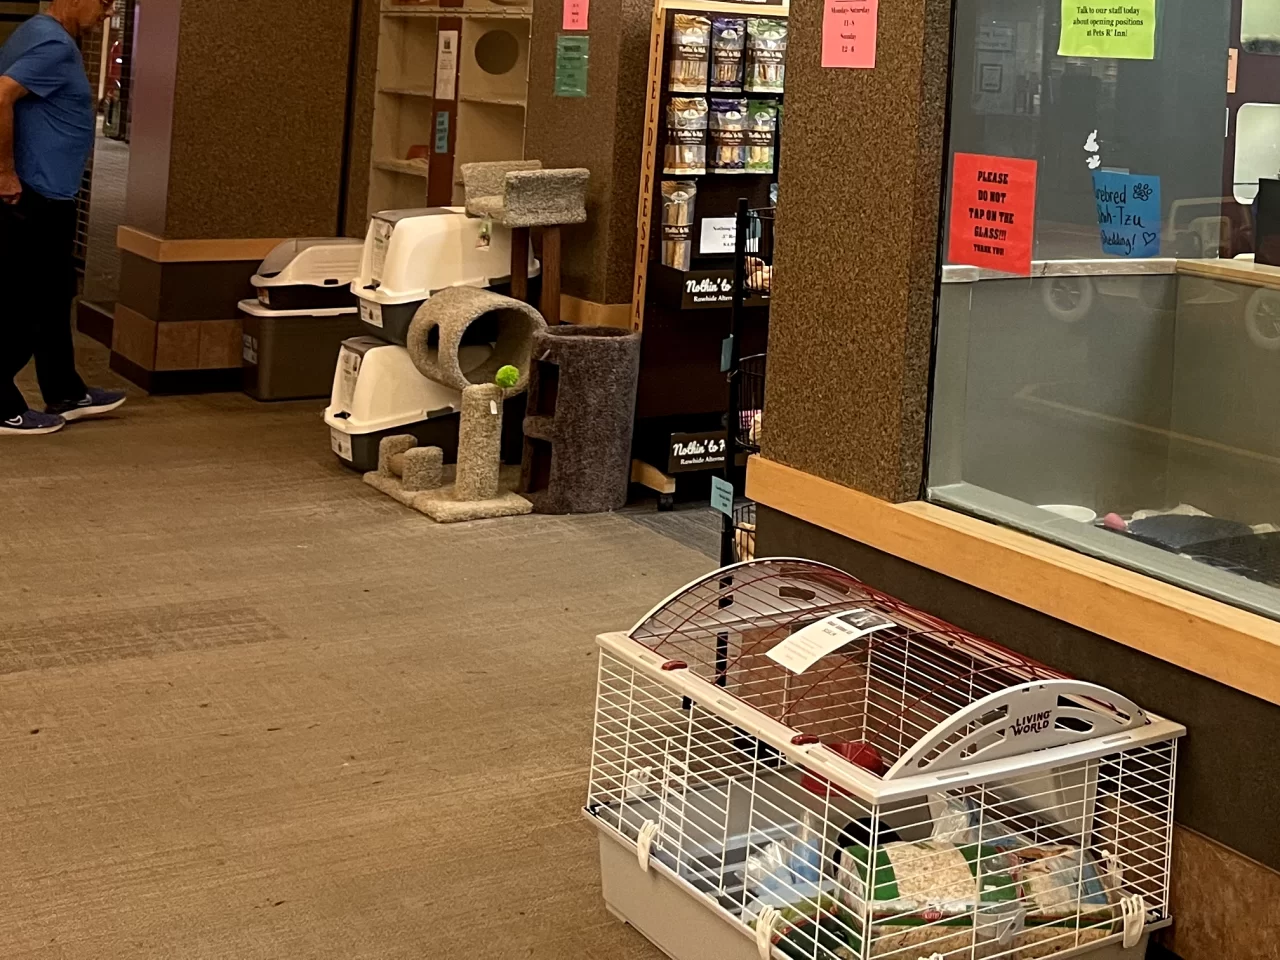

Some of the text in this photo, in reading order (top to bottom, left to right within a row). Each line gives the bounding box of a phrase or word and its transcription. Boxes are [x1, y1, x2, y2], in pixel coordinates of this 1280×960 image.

[1076, 6, 1088, 14] Talk
[1109, 6, 1123, 14] staff
[1123, 6, 1140, 16] today
[1073, 17, 1144, 27] about opening positions
[1093, 29, 1105, 37] Pets
[1114, 29, 1128, 37] Inn!
[977, 171, 1009, 185] PLEASE
[977, 190, 1007, 204] DO NOT
[968, 208, 1014, 224] TAP ON THE
[974, 226, 1007, 241] GLASS!!!
[973, 243, 992, 255] THANK
[685, 277, 721, 293] Nothin'
[673, 439, 708, 457] Nothin'
[1015, 710, 1051, 727] LIVING
[1008, 720, 1050, 737] WORLD
